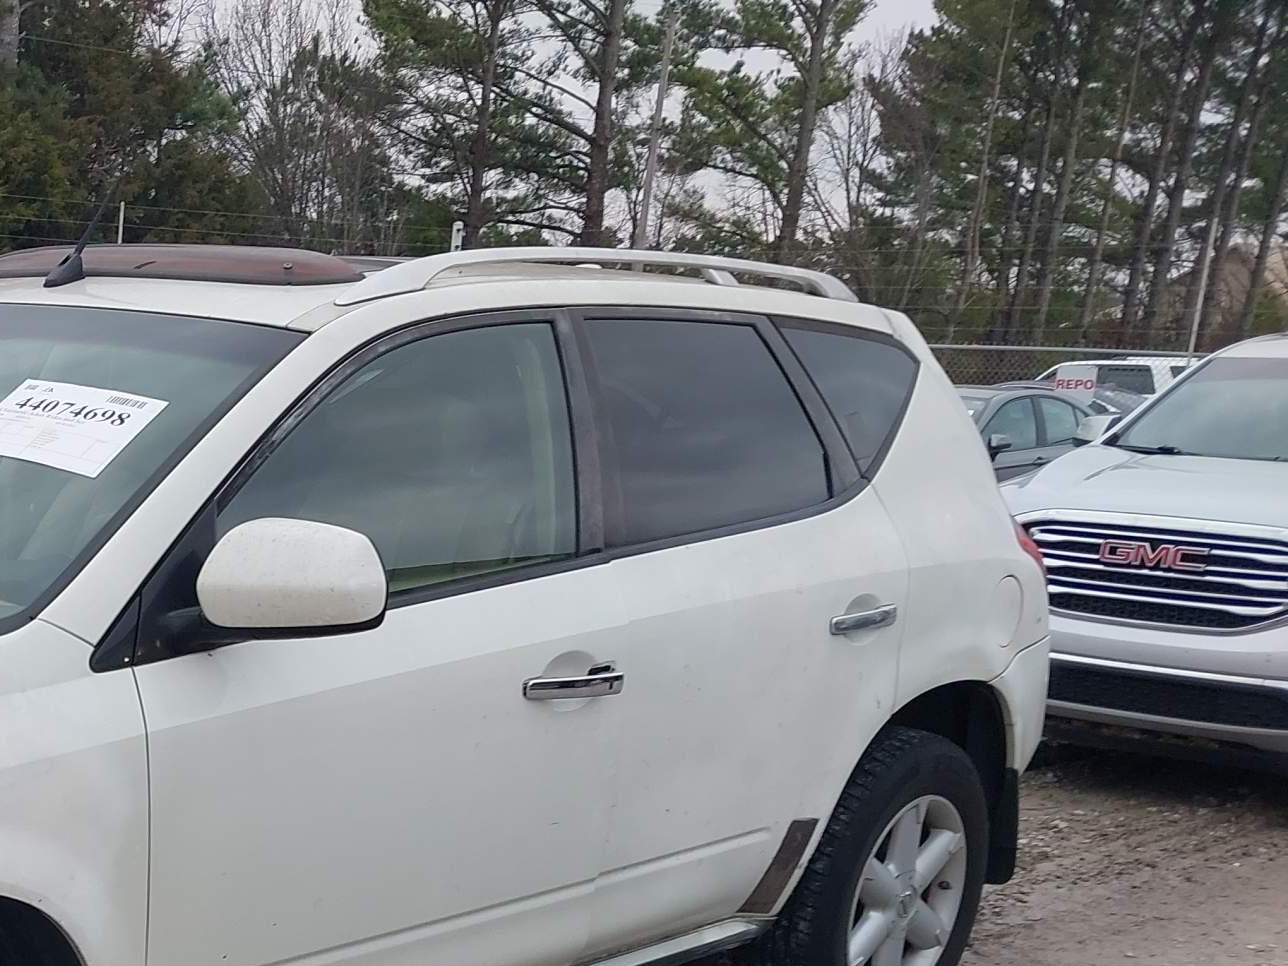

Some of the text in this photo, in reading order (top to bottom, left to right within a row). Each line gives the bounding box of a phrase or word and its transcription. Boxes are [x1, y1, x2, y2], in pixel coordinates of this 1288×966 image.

[1055, 378, 1095, 390] REPO
[15, 396, 131, 426] 44074698
[1100, 540, 1209, 571] GMC
